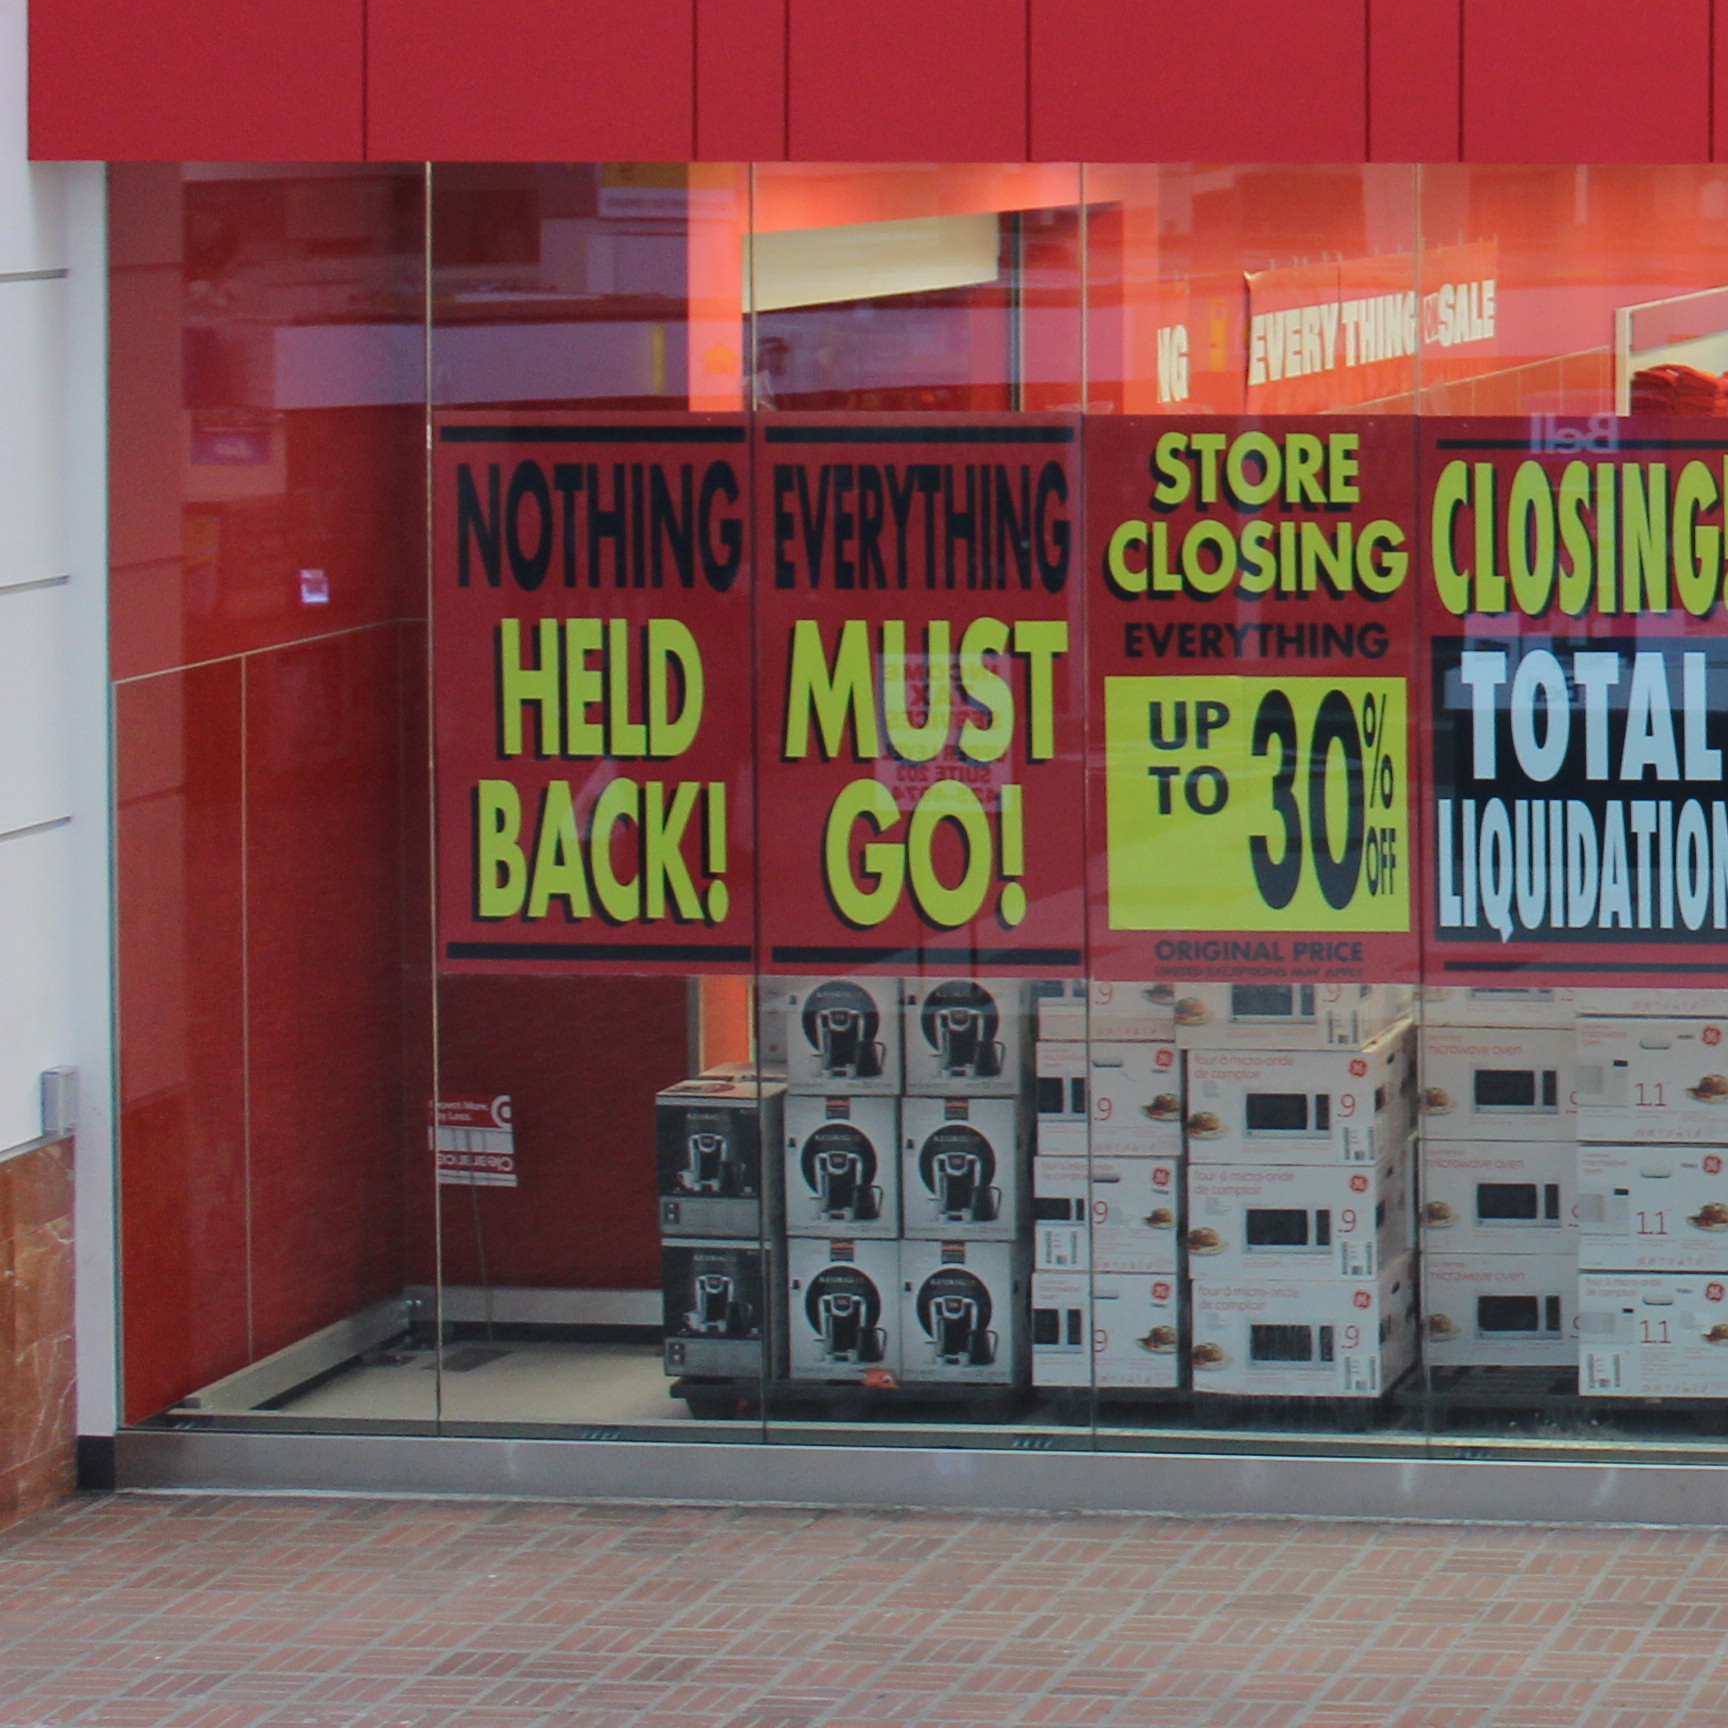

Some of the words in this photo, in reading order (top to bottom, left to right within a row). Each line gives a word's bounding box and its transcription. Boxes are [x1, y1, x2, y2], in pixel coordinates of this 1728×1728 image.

[1438, 278, 1496, 347] SALE
[455, 459, 743, 592] NOTHING
[773, 461, 1071, 594] EVERYTHING
[1151, 431, 1360, 511] STORE
[1106, 519, 1408, 601] CLOSING
[497, 617, 705, 761] HELD
[783, 616, 1068, 762] MUST
[1124, 622, 1389, 660] EVERYTHING
[1148, 700, 1231, 751] UP
[1461, 649, 1723, 783] TOTAL
[473, 777, 729, 924] BACK!
[823, 779, 1027, 928] GO!
[1148, 764, 1231, 816] TO
[1366, 826, 1397, 896] OFF
[1155, 941, 1284, 962] ORIGINAL
[1293, 941, 1363, 962] PRICE
